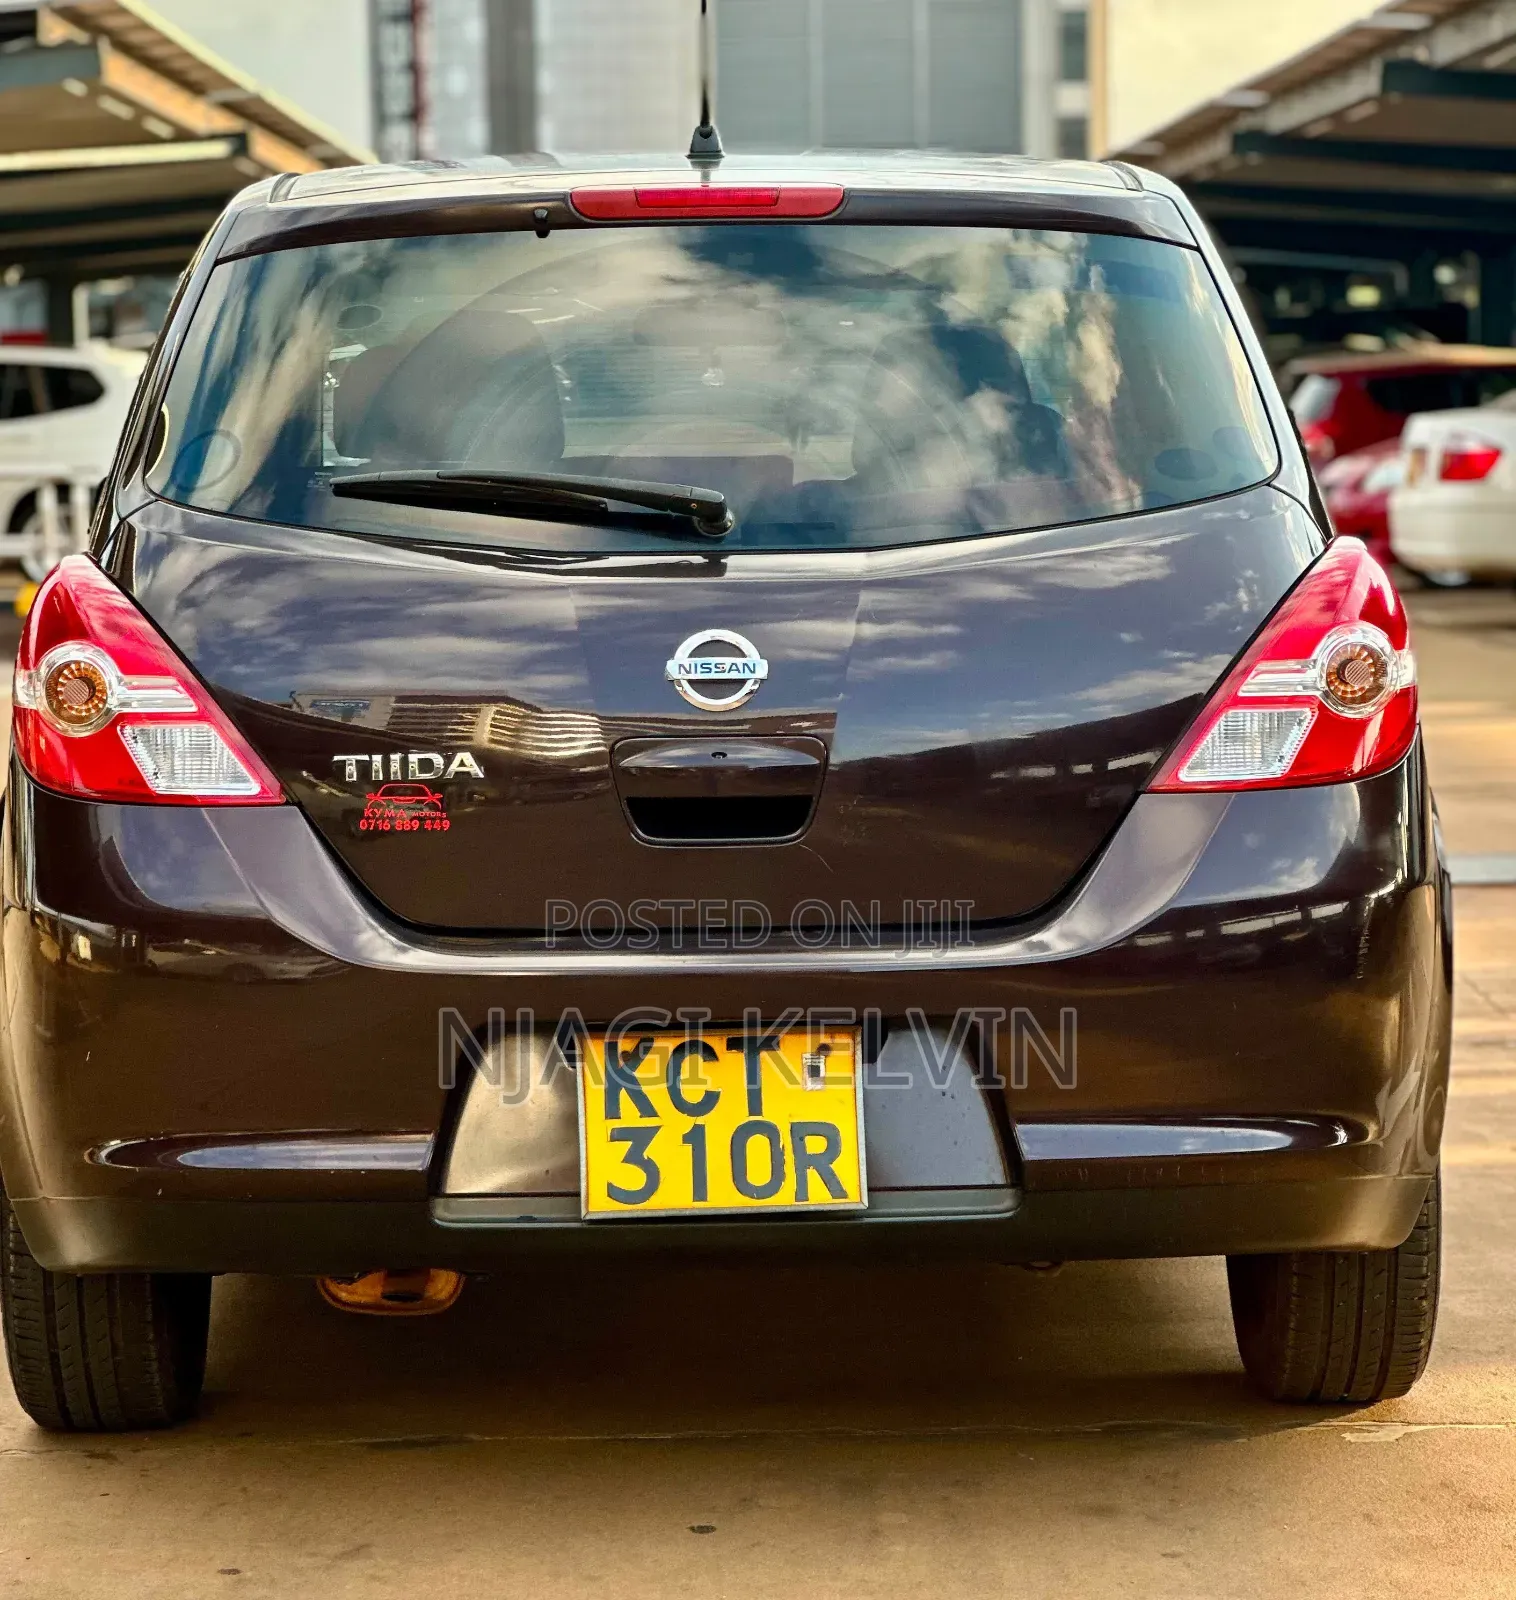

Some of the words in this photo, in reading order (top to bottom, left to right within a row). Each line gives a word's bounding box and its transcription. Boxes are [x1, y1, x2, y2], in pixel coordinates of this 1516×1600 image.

[677, 662, 756, 675] NISSAN
[332, 751, 485, 782] TIIDA
[363, 808, 408, 818] KYMA
[359, 819, 391, 831] 0716
[424, 819, 450, 831] 449
[604, 1036, 780, 1120] KCT
[606, 1119, 848, 1206] 310R
